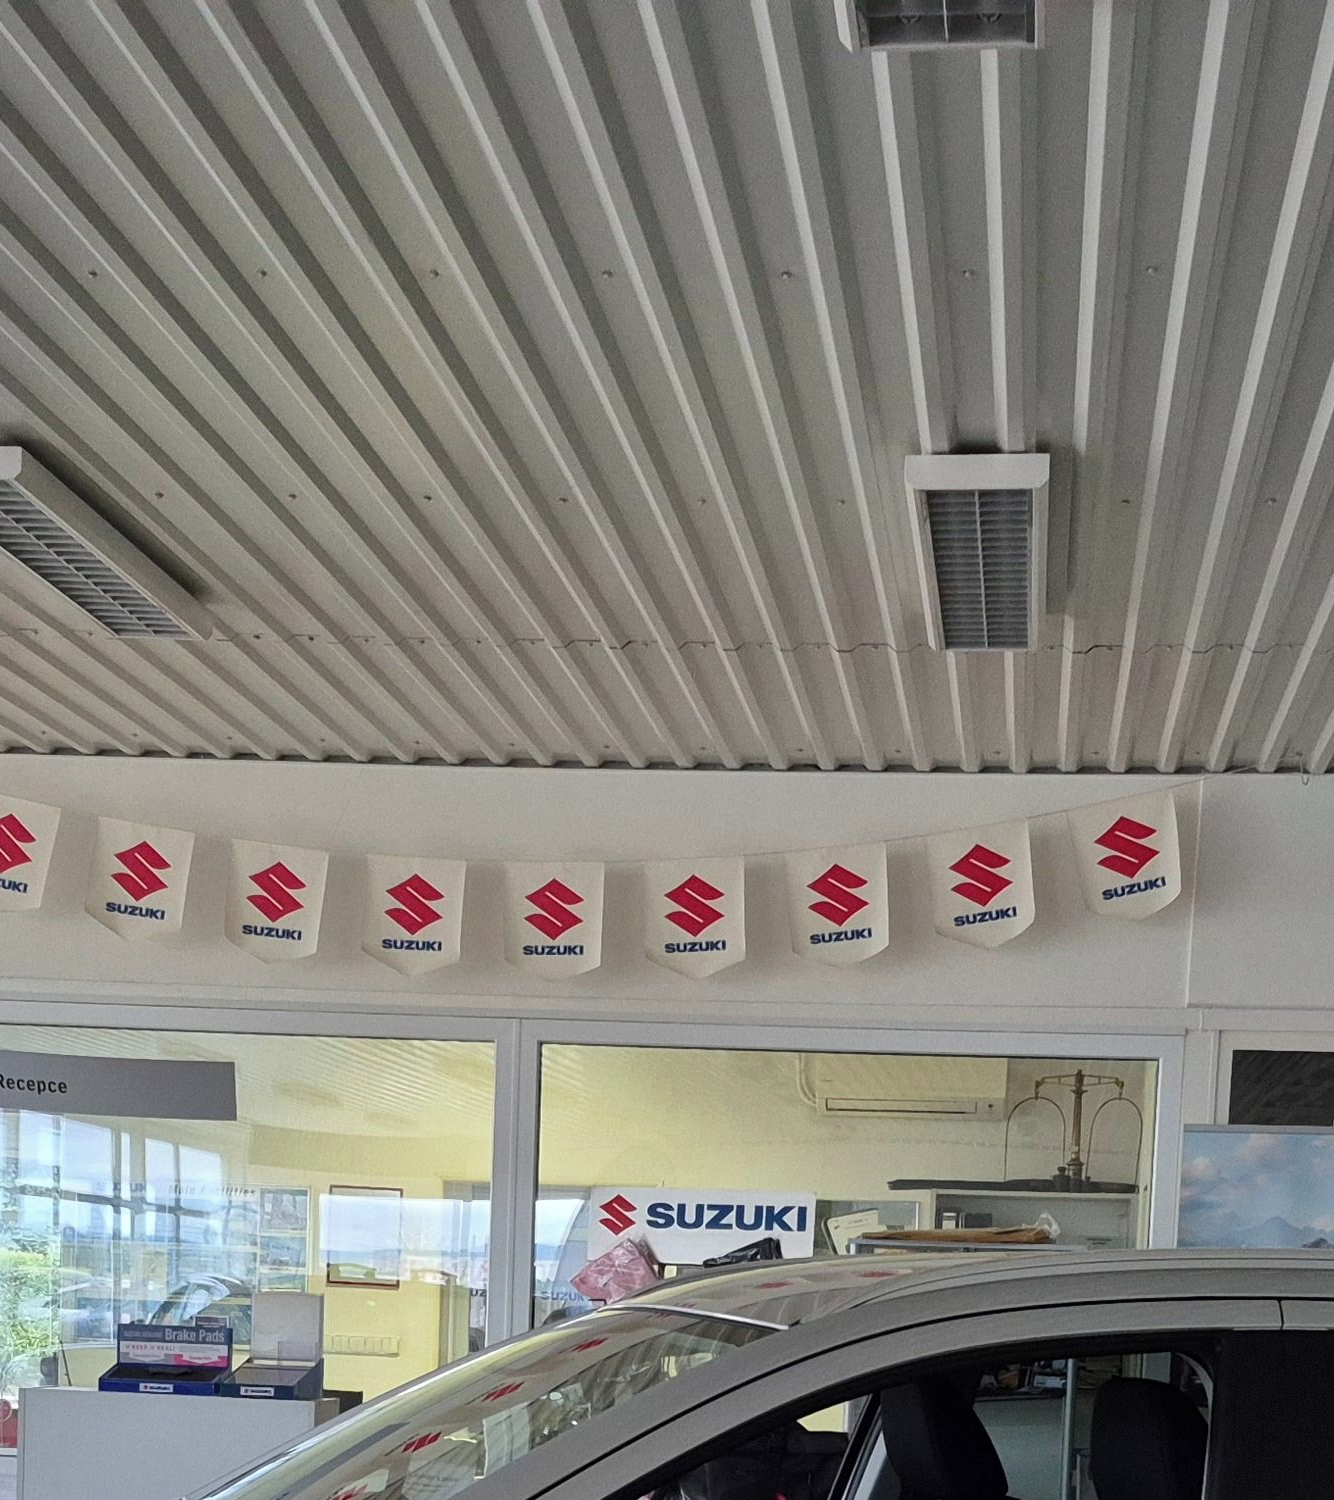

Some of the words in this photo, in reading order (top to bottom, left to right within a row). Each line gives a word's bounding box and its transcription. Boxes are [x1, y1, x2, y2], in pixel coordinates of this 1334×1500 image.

[1102, 876, 1167, 901] SUZUKI
[105, 902, 165, 920] SUZUKI
[953, 906, 1017, 927] SUZUKI
[242, 924, 302, 941] SUZUKI
[809, 927, 873, 945] SUZUKI
[381, 938, 442, 952] SUZUKI
[522, 945, 584, 957] SUZUKI
[664, 940, 727, 954] SUZUKI
[646, 1202, 808, 1232] SUZUKI
[540, 1291, 585, 1301] SUZUK
[165, 1328, 195, 1341] Brake
[199, 1329, 225, 1343] Pads
